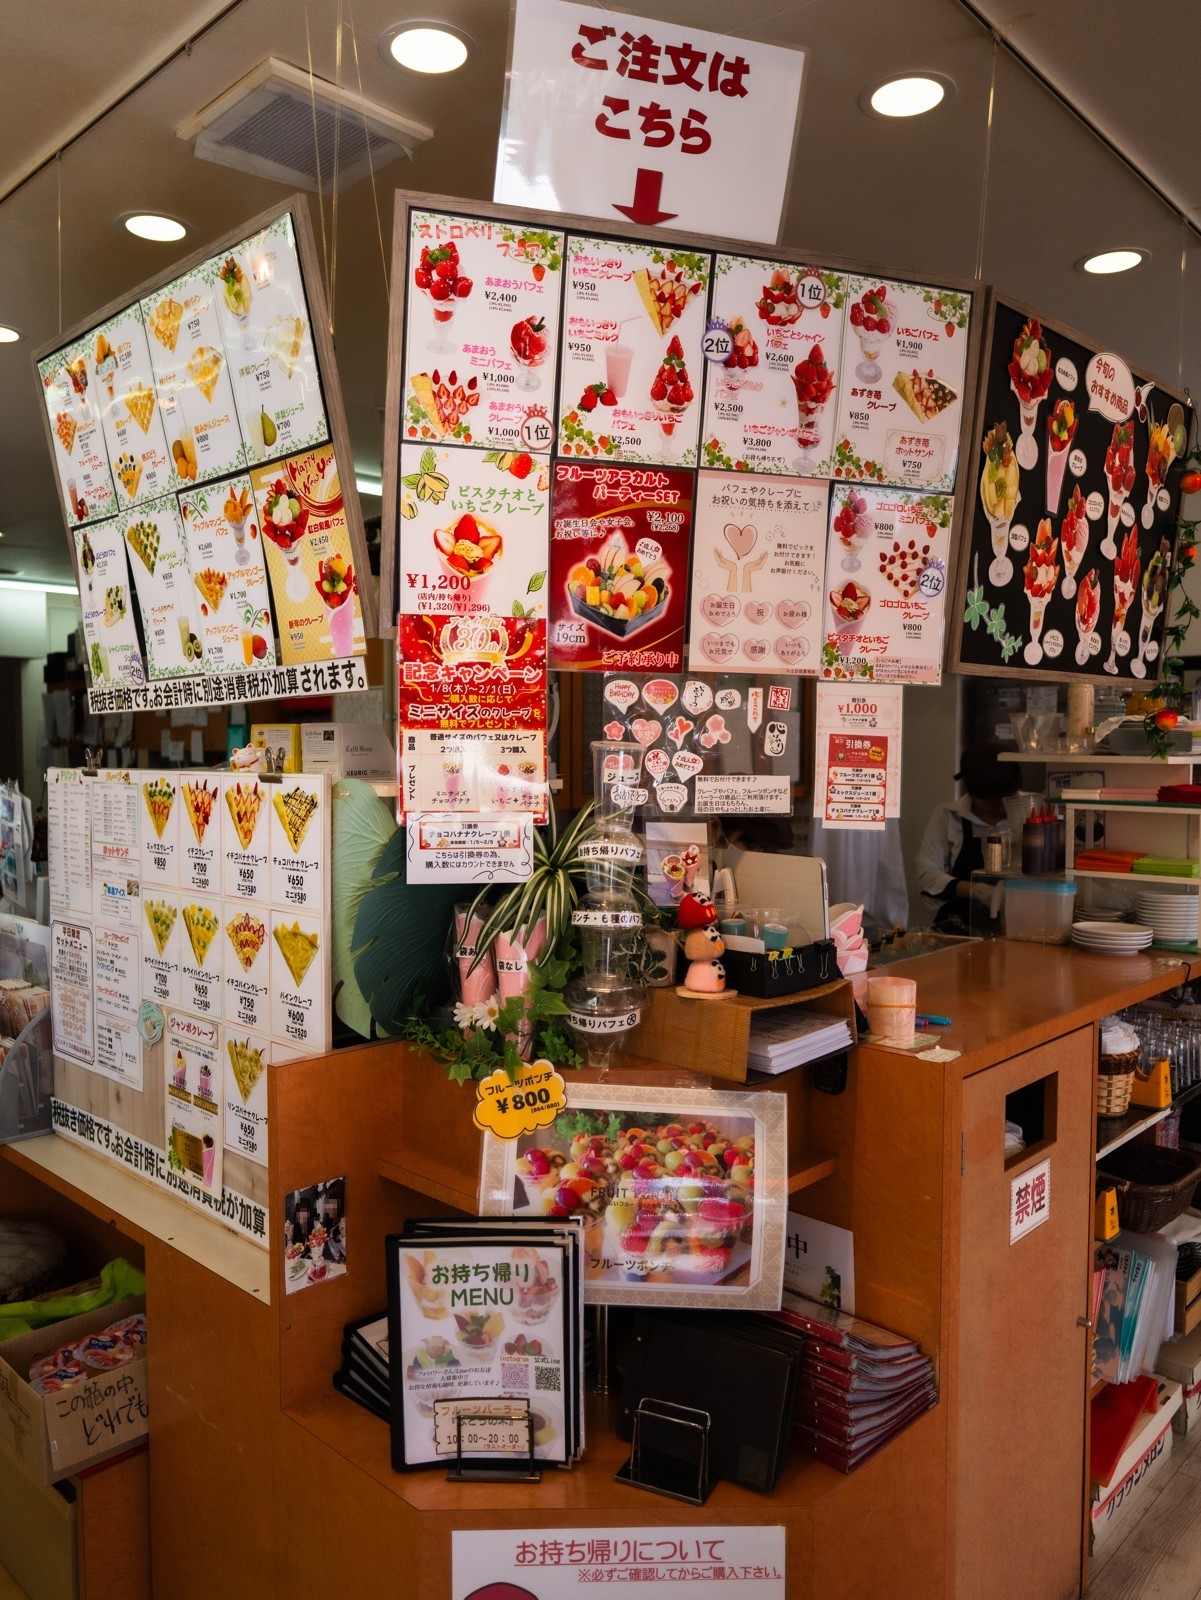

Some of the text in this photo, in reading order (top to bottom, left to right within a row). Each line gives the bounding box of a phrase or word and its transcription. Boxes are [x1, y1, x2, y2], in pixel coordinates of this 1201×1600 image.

[571, 24, 750, 98] ご注文は
[595, 95, 712, 154] こちら
[573, 254, 622, 269] おもいっきり
[572, 267, 633, 283] いちごクレープ
[485, 276, 544, 295] あまおうパフェ
[572, 280, 596, 292] ¥950
[484, 290, 517, 304] ¥2,400
[800, 283, 822, 301] 1位
[187, 318, 201, 330] ¥750
[569, 316, 617, 330] おもいっきり
[568, 328, 619, 342] いちごミルク
[766, 328, 825, 343] いちごとシャイン
[896, 327, 939, 342] いちごパフェ
[462, 344, 496, 357] あまおう
[568, 342, 592, 353] ¥950
[704, 338, 730, 354] 2位
[765, 339, 788, 351] パフェ
[896, 339, 923, 351] ¥1,900
[470, 356, 512, 371] ミニパフェ
[765, 352, 794, 363] ¥2,600
[255, 369, 271, 382] ¥750
[1096, 357, 1115, 382] 今旬の
[483, 372, 515, 385] ¥1,000
[851, 388, 882, 400] あずき苺
[1091, 380, 1129, 416] おすすめ商品
[274, 402, 305, 421] 洋梨ジュース
[714, 402, 744, 413] ¥2,500
[866, 401, 897, 412] クレープ
[488, 413, 523, 425] クレープ
[849, 411, 870, 422] ¥850
[276, 419, 292, 431] ¥700
[611, 420, 636, 431] パフェ
[196, 433, 210, 444] ¥800
[488, 427, 520, 438] ¥1,000
[524, 425, 551, 441] 1位
[611, 435, 642, 446] ¥2,500
[743, 437, 772, 448] ¥3,800
[899, 436, 930, 447] あずき苺
[895, 446, 934, 459] ホットサンド
[901, 460, 922, 470] ¥750
[557, 466, 670, 487] フルーツアラカルト
[459, 485, 537, 502] ピスタチオと
[593, 484, 680, 504] パーティーSET
[722, 484, 802, 499] パフェやクレープに
[451, 500, 545, 517] いちごクレープ
[712, 495, 810, 511] お祝いの気持ちを添えて
[875, 502, 925, 514] ゴロゴロいちご
[646, 511, 684, 524] ¥2,100
[898, 515, 932, 526] ミニパフェ
[193, 516, 227, 532] アップルマンゴー
[651, 524, 679, 532] (¥2,268)
[874, 522, 894, 532] ¥800
[215, 527, 229, 537] パフェ
[198, 542, 213, 552] ¥2,600
[309, 535, 329, 547] ¥2,450
[226, 566, 264, 581] アップルマンゴー
[245, 575, 265, 588] クレープ
[406, 573, 471, 590] ¥1,200
[920, 574, 942, 590] 2位
[229, 590, 247, 601] ¥1,700
[879, 599, 927, 610] ゴロゴロいちご
[708, 610, 737, 618] おめでとう
[756, 609, 765, 617] 祝
[902, 611, 930, 621] クレープ
[288, 614, 324, 630] 新年のクレープ
[557, 622, 585, 633] サイズ
[902, 623, 922, 632] ¥800
[205, 624, 239, 636] アップルマンゴー
[556, 633, 586, 644] 19cm
[707, 640, 735, 648] いつまでも
[827, 632, 890, 645] ピスタチオといちご
[207, 646, 223, 655] ¥1,700
[750, 646, 766, 655] 感謝
[785, 642, 802, 650] いつも
[859, 645, 888, 654] クレープ
[602, 650, 680, 668] ご予約承り中
[780, 649, 806, 657] ありがとう
[840, 656, 868, 665] ¥1,200
[130, 665, 144, 680] 2位
[404, 662, 542, 684] 記念キャンペーン
[89, 660, 365, 713] 税抜き価格です。お会計時に別途消費税が加算されます。
[408, 703, 541, 719] ミニサイズのクレープを
[837, 703, 878, 715] ¥1,000
[408, 736, 416, 751] 商品
[845, 739, 872, 750] 引換券
[500, 746, 526, 754] 3つ購入
[60, 770, 77, 782] ドリンク
[408, 765, 416, 801] プレゼント
[103, 845, 129, 857] ホットサンド
[147, 842, 173, 852] ミックスクレープ
[187, 847, 214, 858] イチゴクレープ
[154, 857, 167, 868] ¥850
[226, 852, 268, 863] イチゴバナナクレープ
[272, 856, 319, 869] チョコバナナクレープ
[193, 862, 207, 873] ¥700
[239, 868, 254, 880] ¥650
[287, 874, 304, 887] ¥650
[56, 936, 88, 950] セットメニュー
[498, 960, 523, 971] 袋なし
[155, 973, 168, 984] ¥700
[194, 983, 208, 995] ¥650
[226, 978, 268, 994] イチゴパインクレープ
[239, 996, 254, 1008] ¥750
[279, 992, 313, 1007] パインクレープ
[287, 1009, 304, 1022] ¥600
[170, 1017, 215, 1041] ジャンボクレープ
[485, 1071, 553, 1096] フルーツポンチ
[496, 1088, 551, 1114] ¥800
[240, 1121, 255, 1136] ¥650
[591, 1187, 628, 1199] FRUIT
[1015, 1172, 1046, 1227] 禁煙
[432, 1261, 529, 1284] お持ち帰り
[451, 1287, 514, 1307] MENU
[442, 1404, 523, 1416] フルーツパーラー
[515, 1540, 724, 1563] お持ち帰りについて
[578, 1567, 784, 1581] ※必ずご確認してからご購入下さい。
